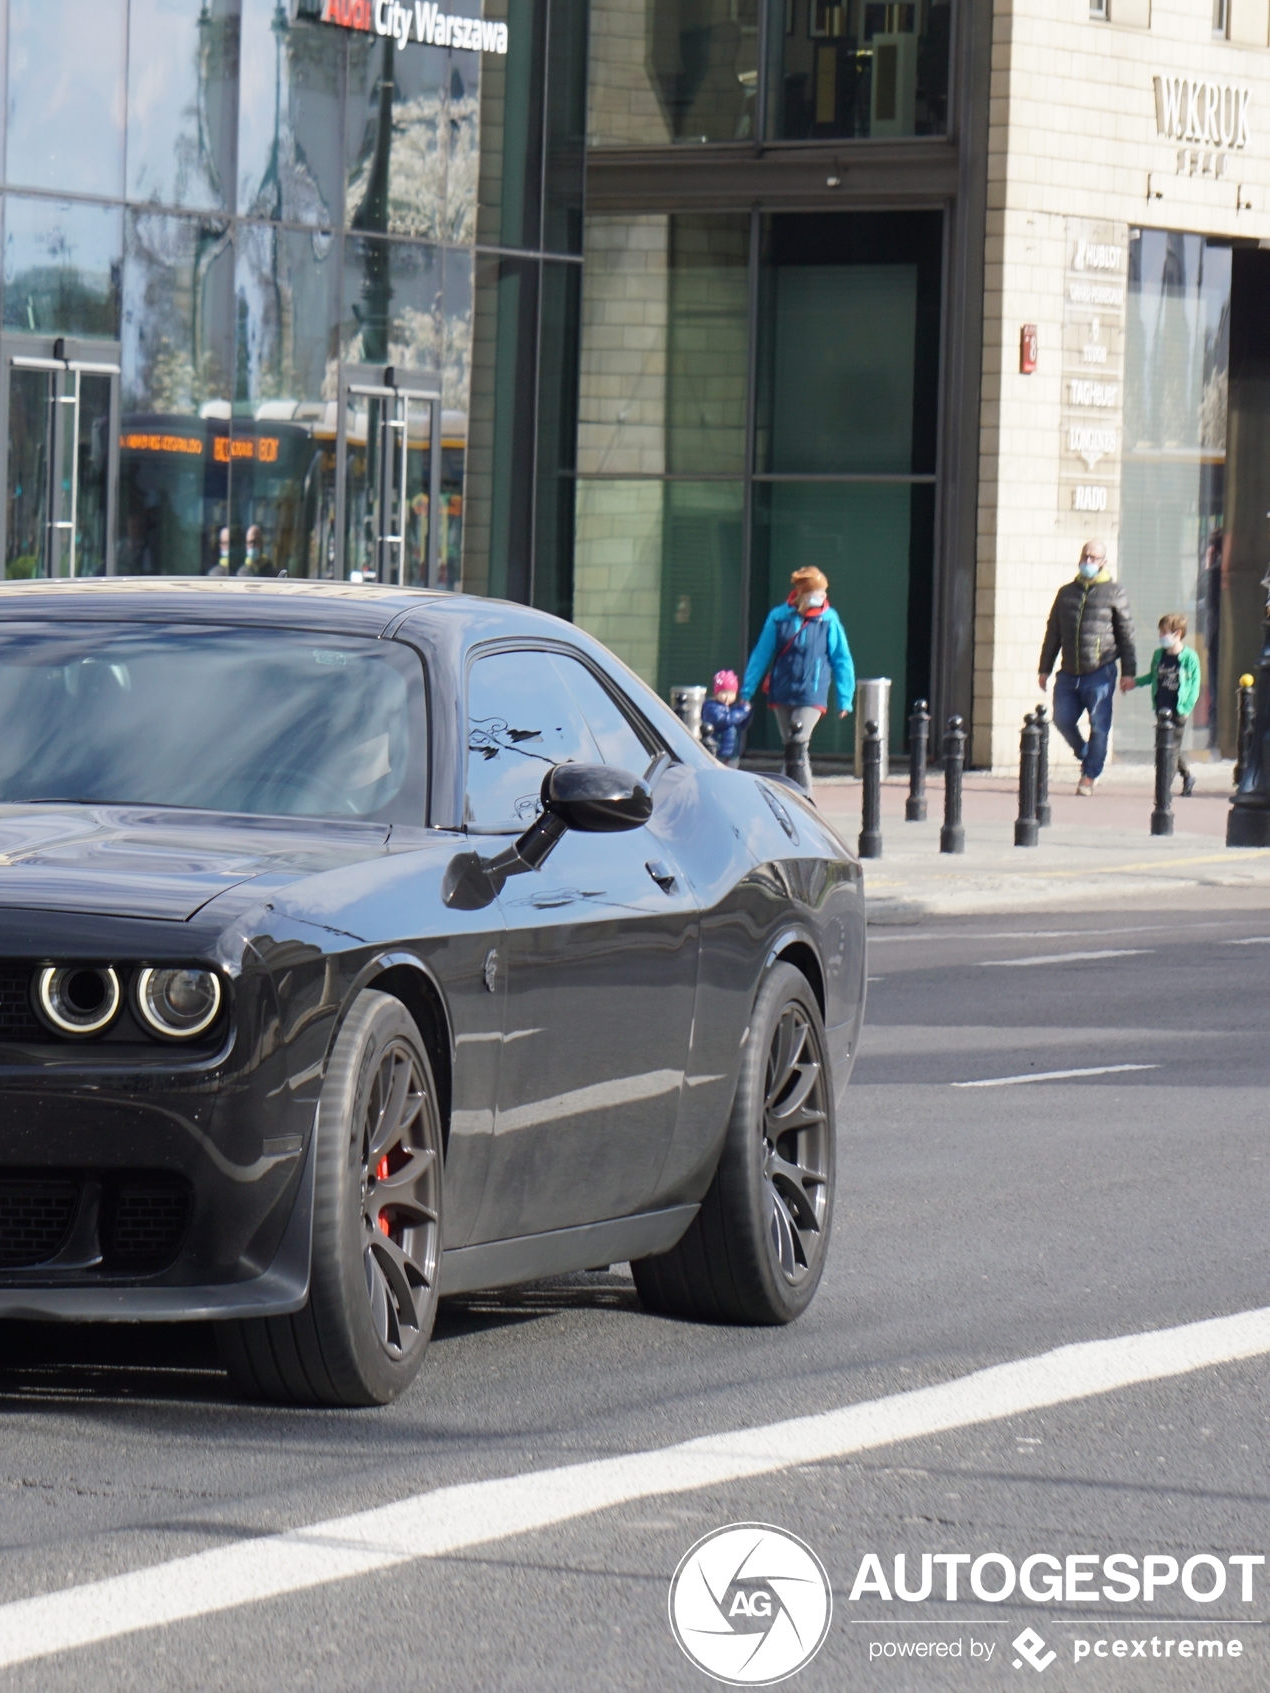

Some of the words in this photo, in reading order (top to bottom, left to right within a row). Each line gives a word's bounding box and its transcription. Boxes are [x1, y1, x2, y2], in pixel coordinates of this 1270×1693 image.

[375, 0, 413, 50] City
[415, 1, 508, 54] Warszawa
[1086, 244, 1122, 268] HUBLOT
[1075, 485, 1107, 511] RADO
